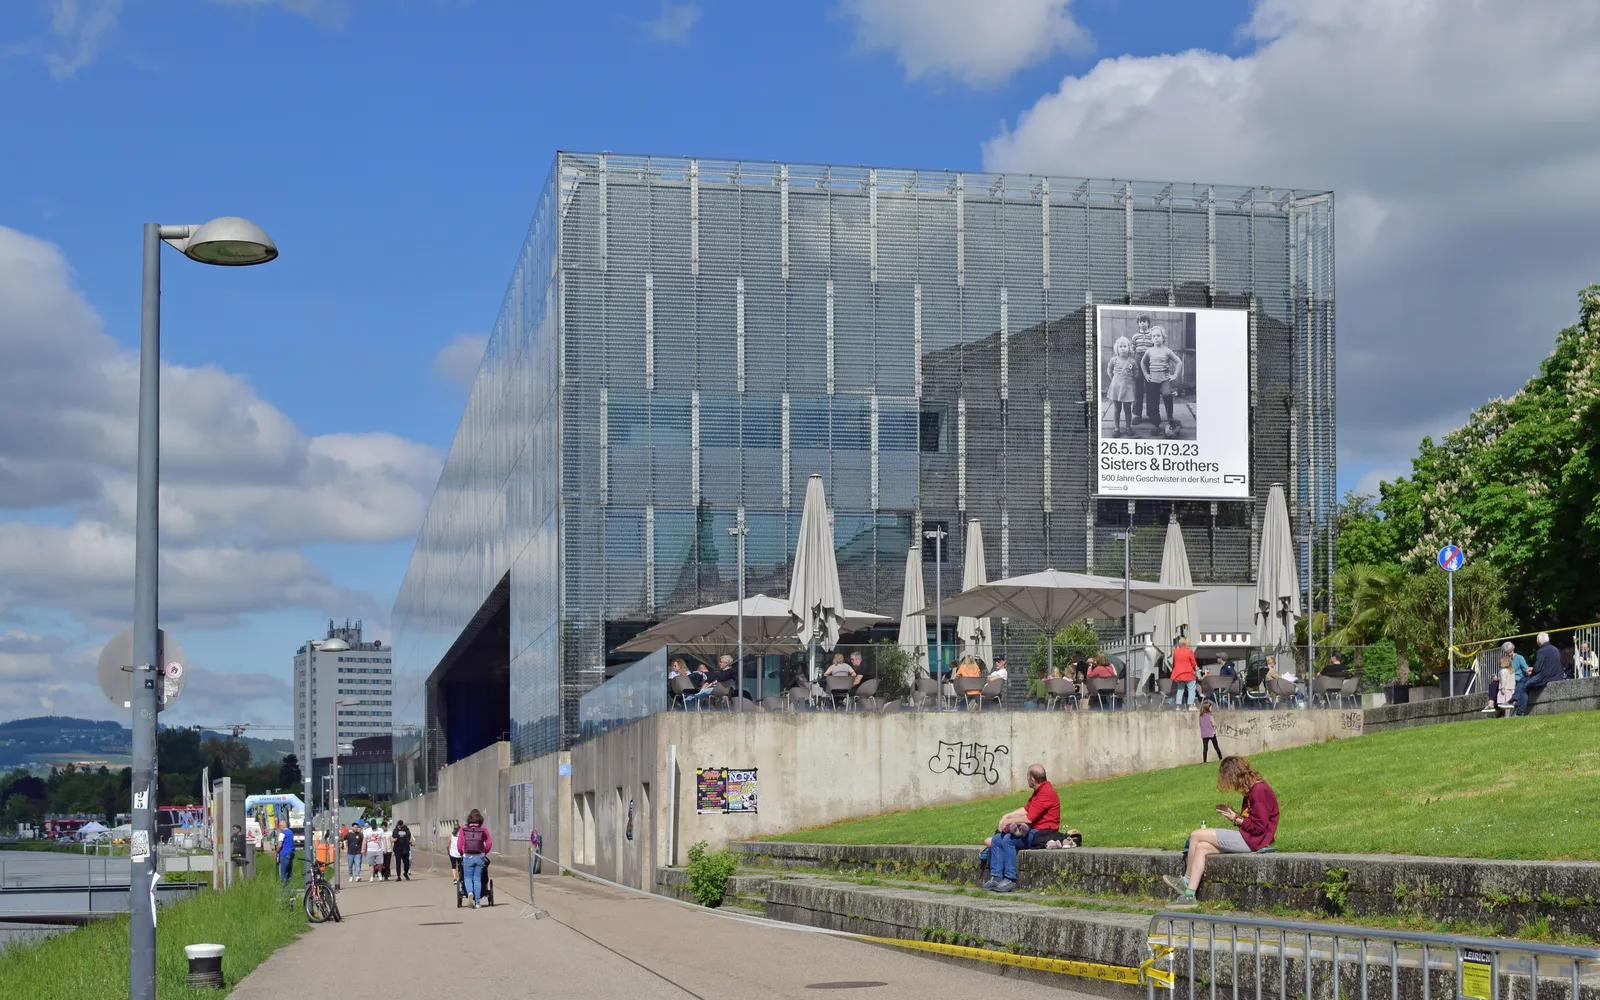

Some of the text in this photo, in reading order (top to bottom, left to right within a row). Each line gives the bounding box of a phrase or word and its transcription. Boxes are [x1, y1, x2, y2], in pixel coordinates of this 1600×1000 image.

[1100, 442, 1199, 456] 26.5. bis 17.9.23
[1101, 457, 1219, 472] Sisters & Brothers
[1101, 474, 1116, 482] 500
[1116, 474, 1135, 482] Jahre
[1135, 475, 1180, 483] Geschwister
[1180, 475, 1187, 483] in
[1187, 475, 1200, 483] der
